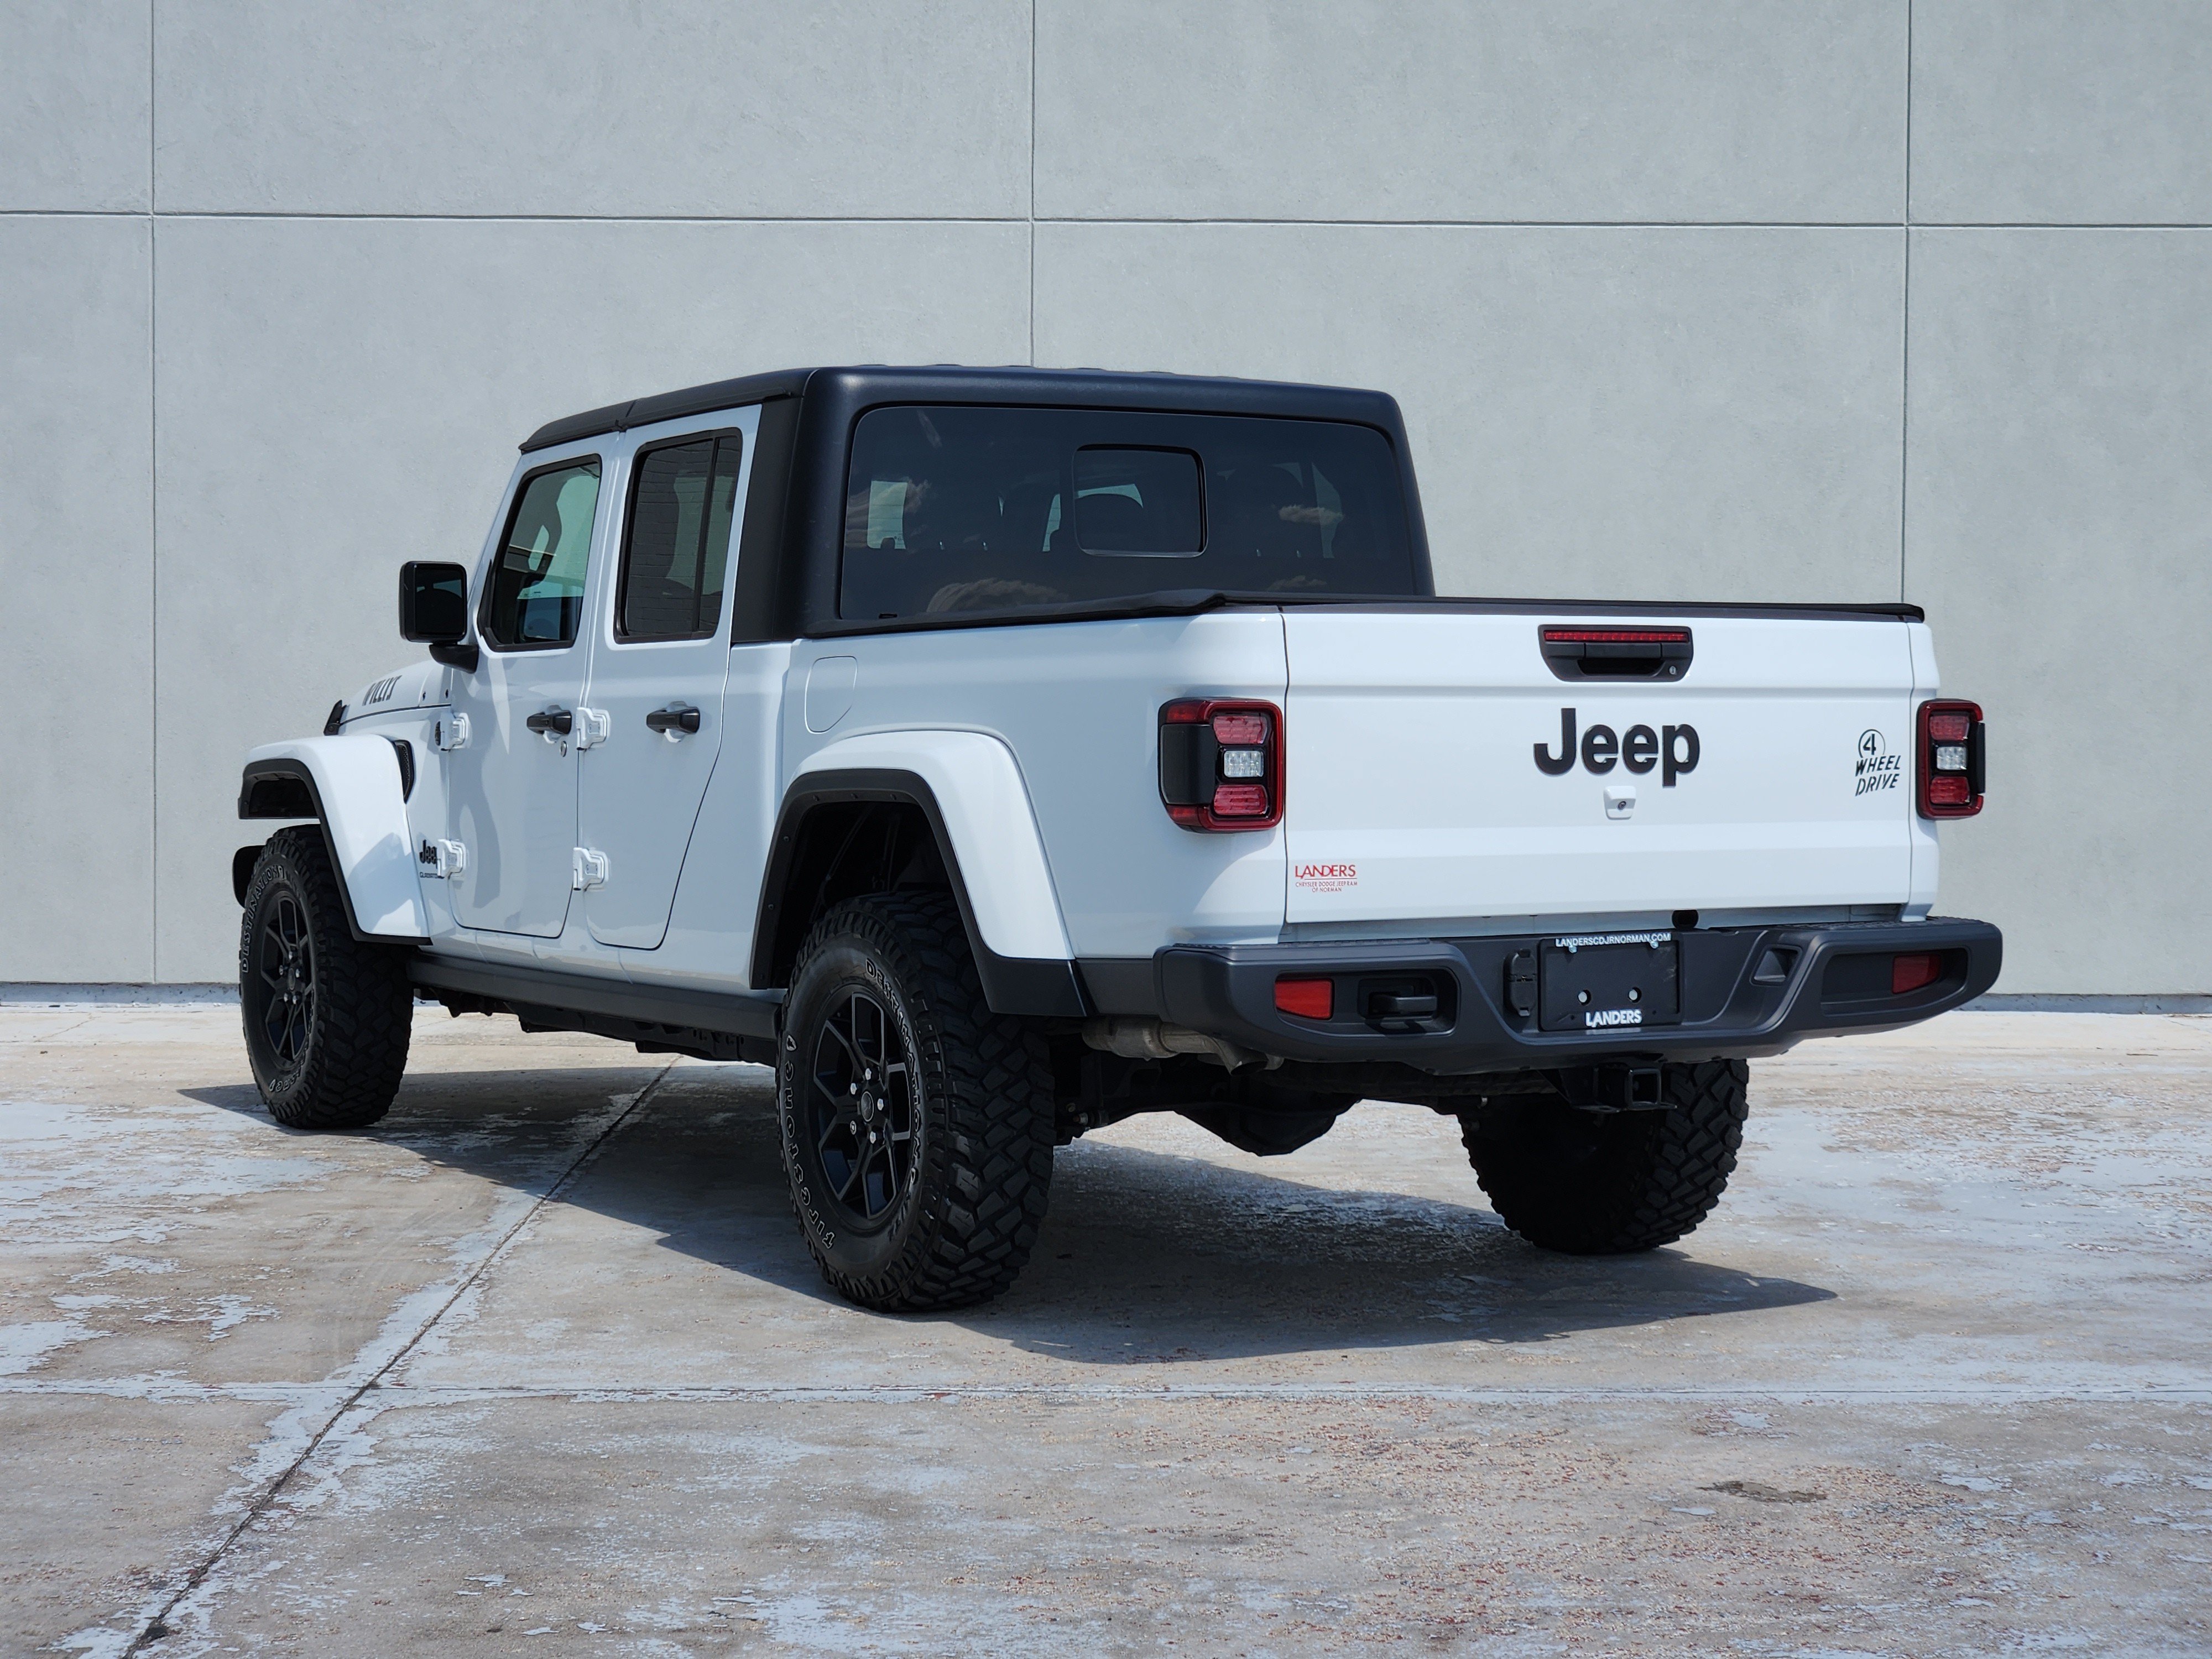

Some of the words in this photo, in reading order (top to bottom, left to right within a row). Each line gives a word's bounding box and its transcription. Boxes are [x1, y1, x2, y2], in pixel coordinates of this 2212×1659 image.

[1533, 708, 1700, 787] Jeep
[1863, 733, 1876, 755] 4
[1855, 755, 1901, 777] WHEEL
[1855, 774, 1900, 796] DRIVE
[1295, 865, 1356, 879] LANDERS
[1556, 932, 1671, 947] LANDERSCDJRNORMAN.COM
[1585, 1009, 1642, 1027] LANDERS
